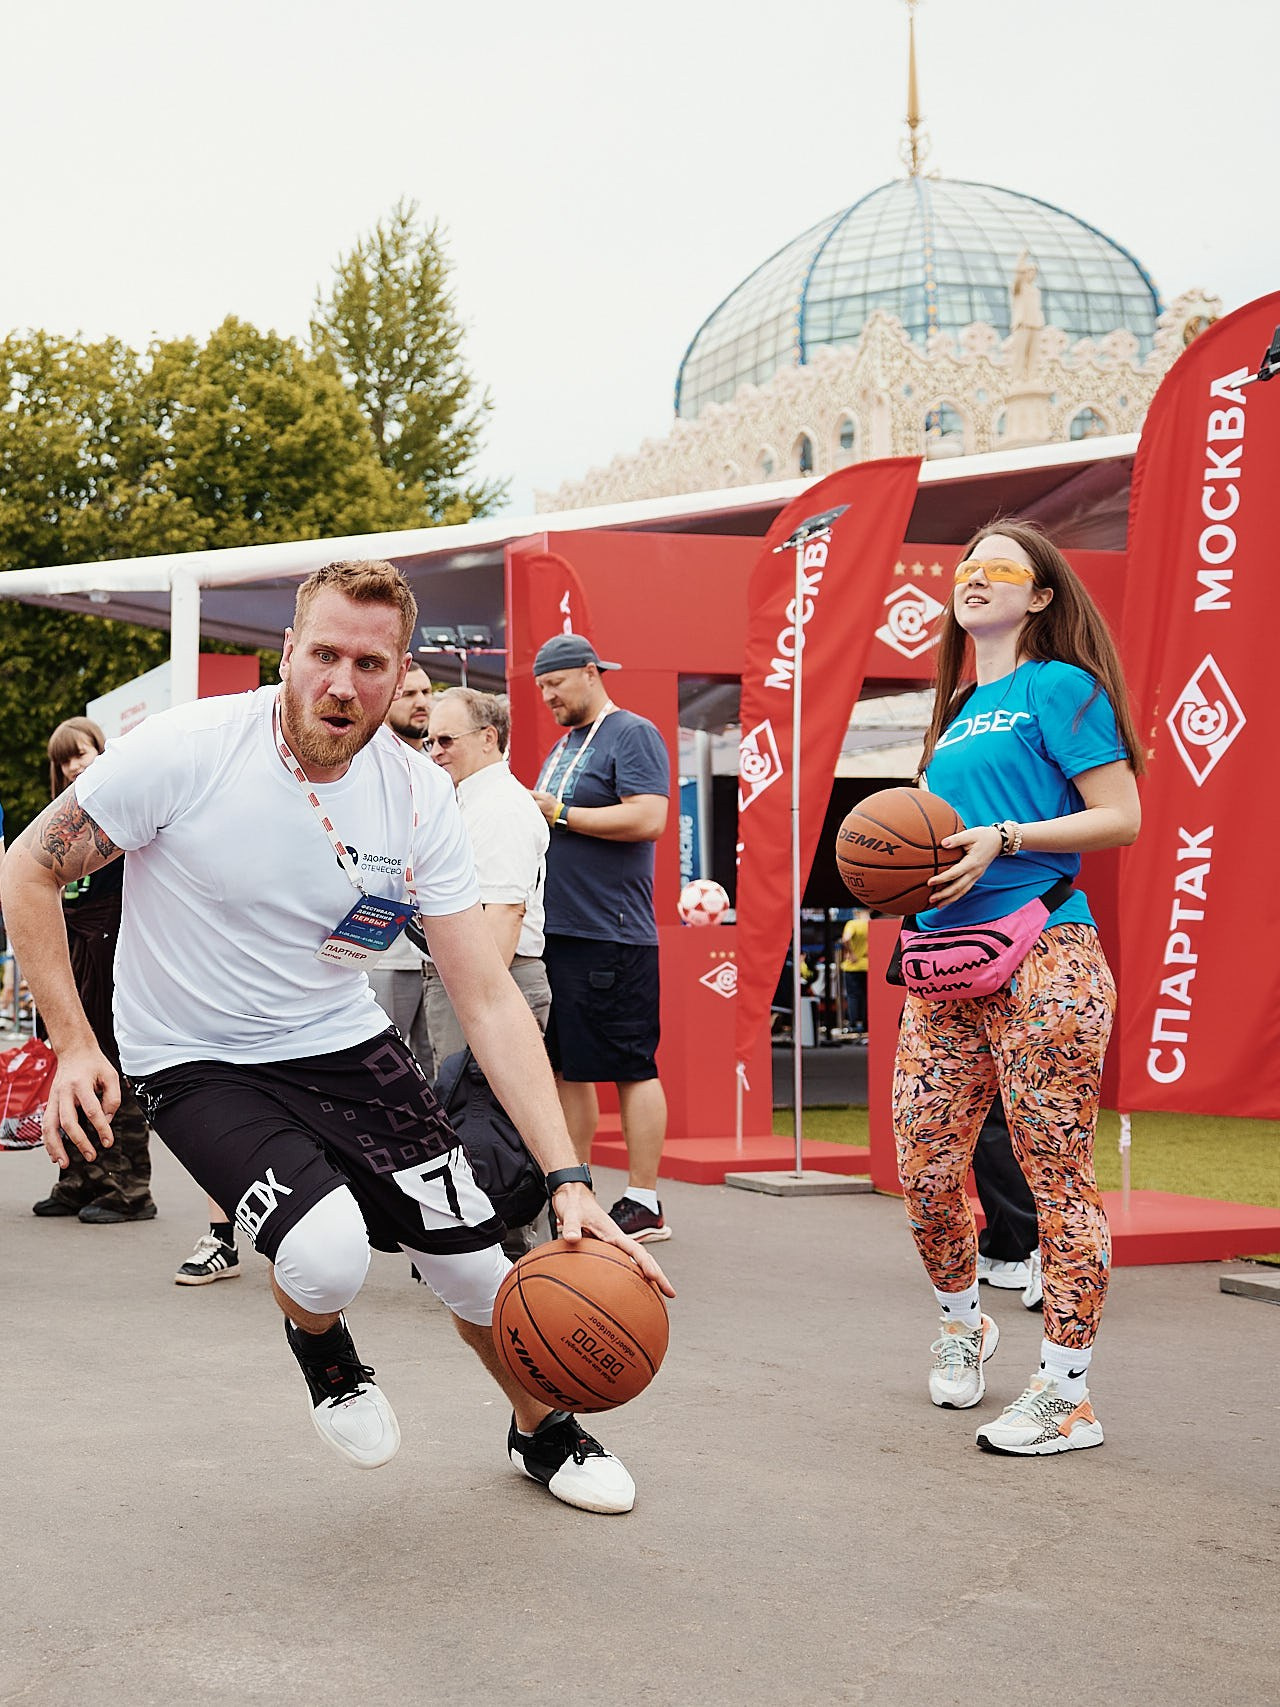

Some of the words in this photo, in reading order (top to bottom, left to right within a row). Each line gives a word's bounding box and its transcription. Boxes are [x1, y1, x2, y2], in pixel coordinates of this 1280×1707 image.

[1194, 367, 1249, 613] МОСКВА
[764, 528, 833, 690] МОСКВ
[839, 828, 902, 855] DEMIX
[352, 914, 390, 928] ПЕРВЫХ
[325, 944, 367, 960] ПАРТНЕР
[1147, 825, 1214, 1084] СПАРТАК
[420, 1164, 464, 1220] 7
[507, 1326, 583, 1407] DEMIX
[572, 1328, 625, 1377] DB700
